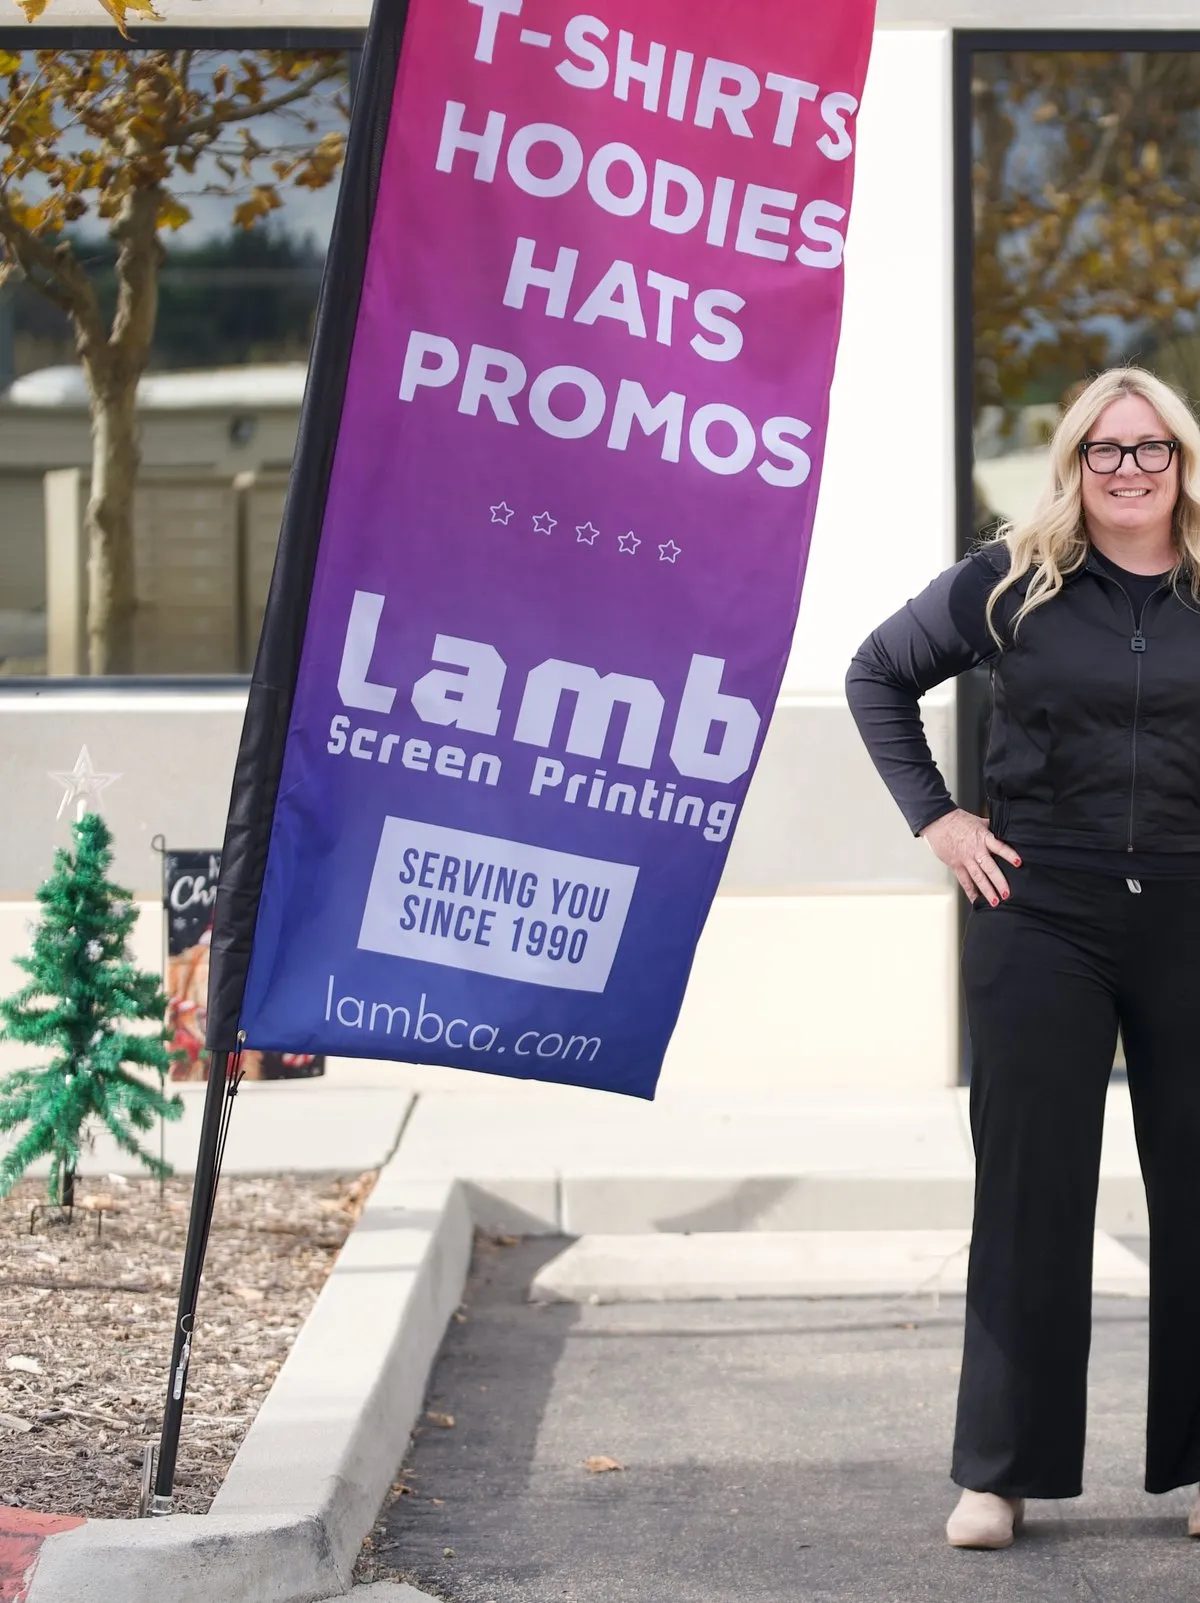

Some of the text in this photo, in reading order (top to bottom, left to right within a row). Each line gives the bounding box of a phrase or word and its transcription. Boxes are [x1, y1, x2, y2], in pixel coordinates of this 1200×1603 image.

[467, 0, 859, 161] T-SHIRTS
[435, 100, 847, 269] HOODIES
[502, 236, 746, 362] HATS
[398, 330, 812, 488] PROMOS
[336, 590, 762, 784] Lamb
[327, 714, 737, 843] Screen Printing
[399, 847, 610, 923] SERVING YOU
[399, 894, 589, 965] SINCE 1990
[323, 974, 602, 1062] lambca.com
